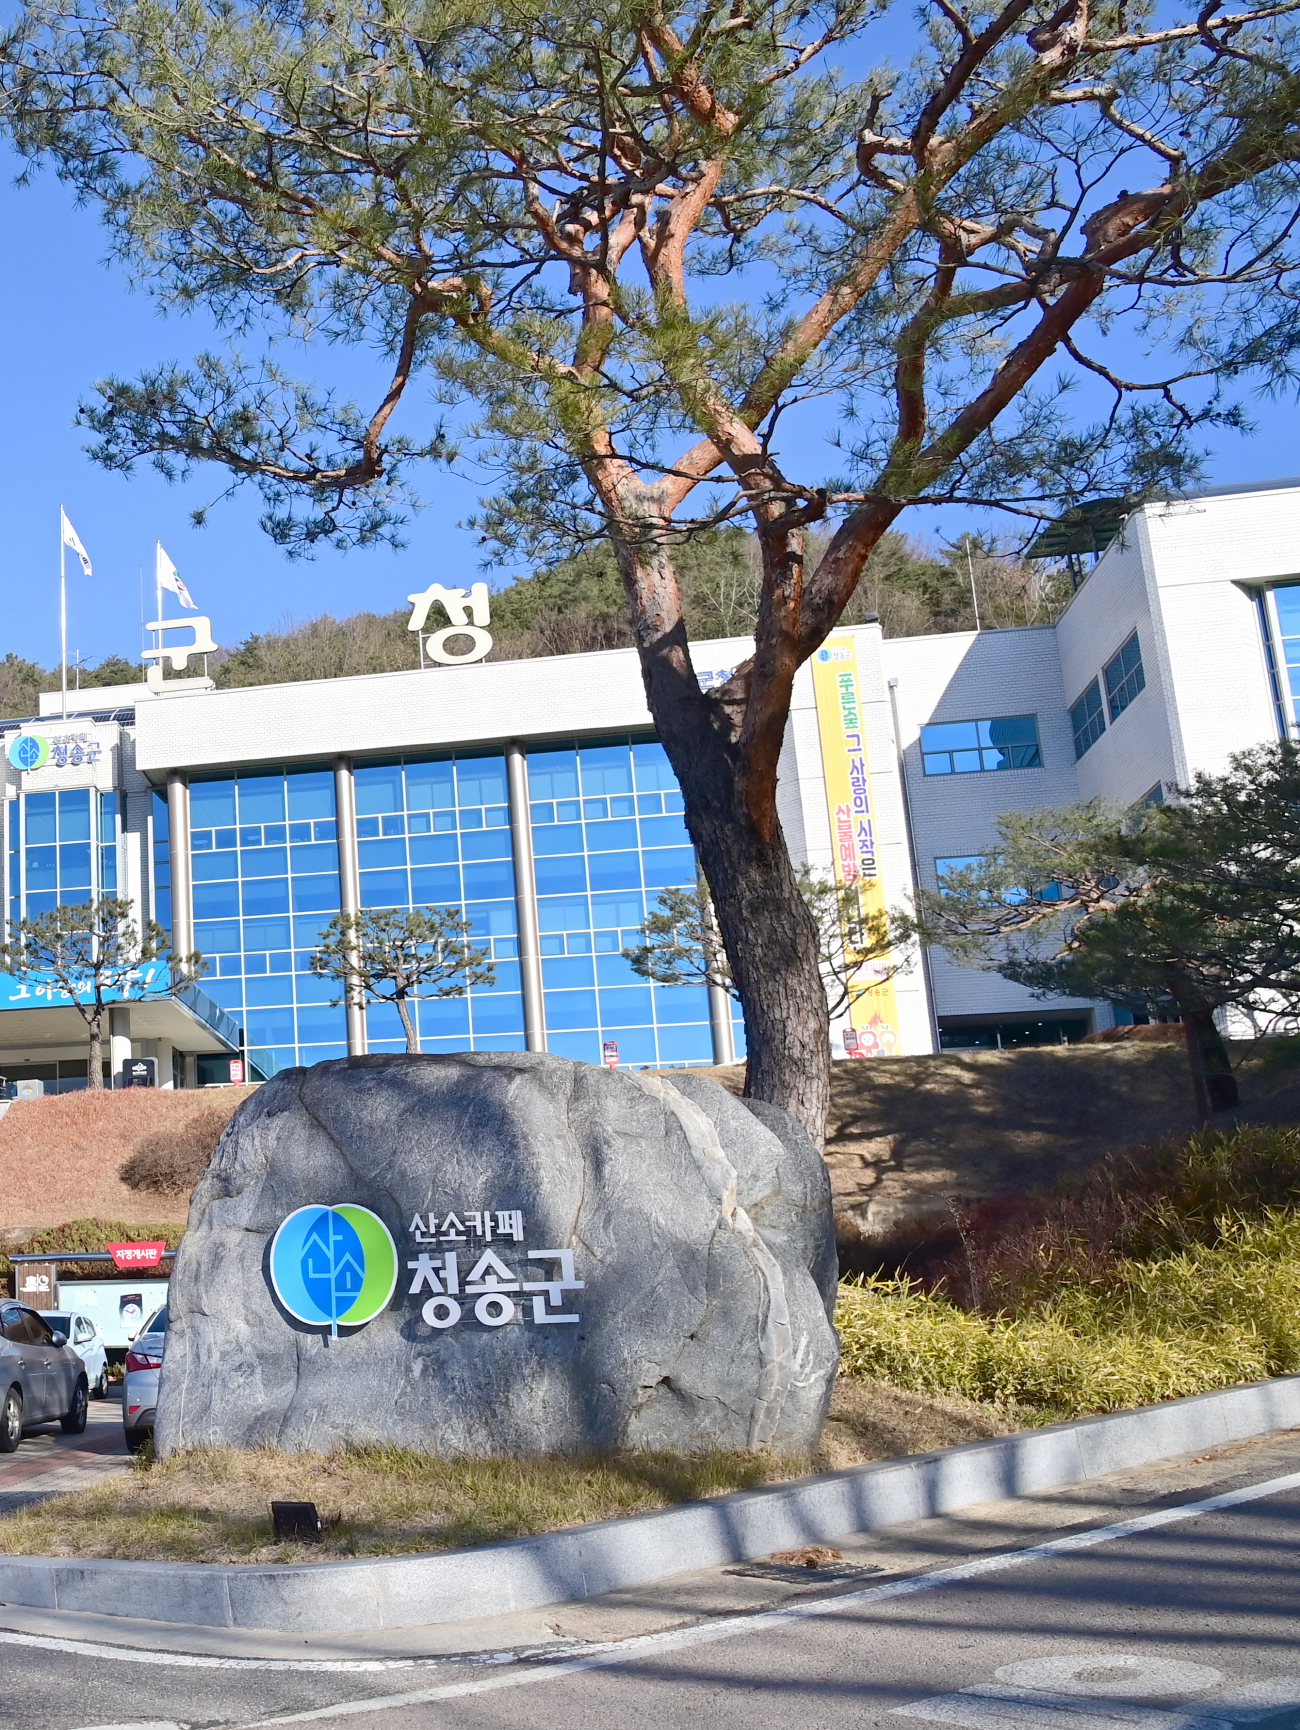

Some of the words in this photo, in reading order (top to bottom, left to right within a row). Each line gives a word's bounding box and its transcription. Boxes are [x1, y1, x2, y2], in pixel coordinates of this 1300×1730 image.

[838, 673, 859, 730] 푸른숲
[53, 742, 102, 765] 청송군
[846, 734, 863, 753] 그
[850, 756, 870, 814] 사랑의
[857, 818, 877, 878] 시작은
[8, 984, 31, 1001] 그
[408, 1209, 524, 1243] 산소카페
[115, 1248, 157, 1260] 지정게시판
[407, 1248, 585, 1328] 청송군
